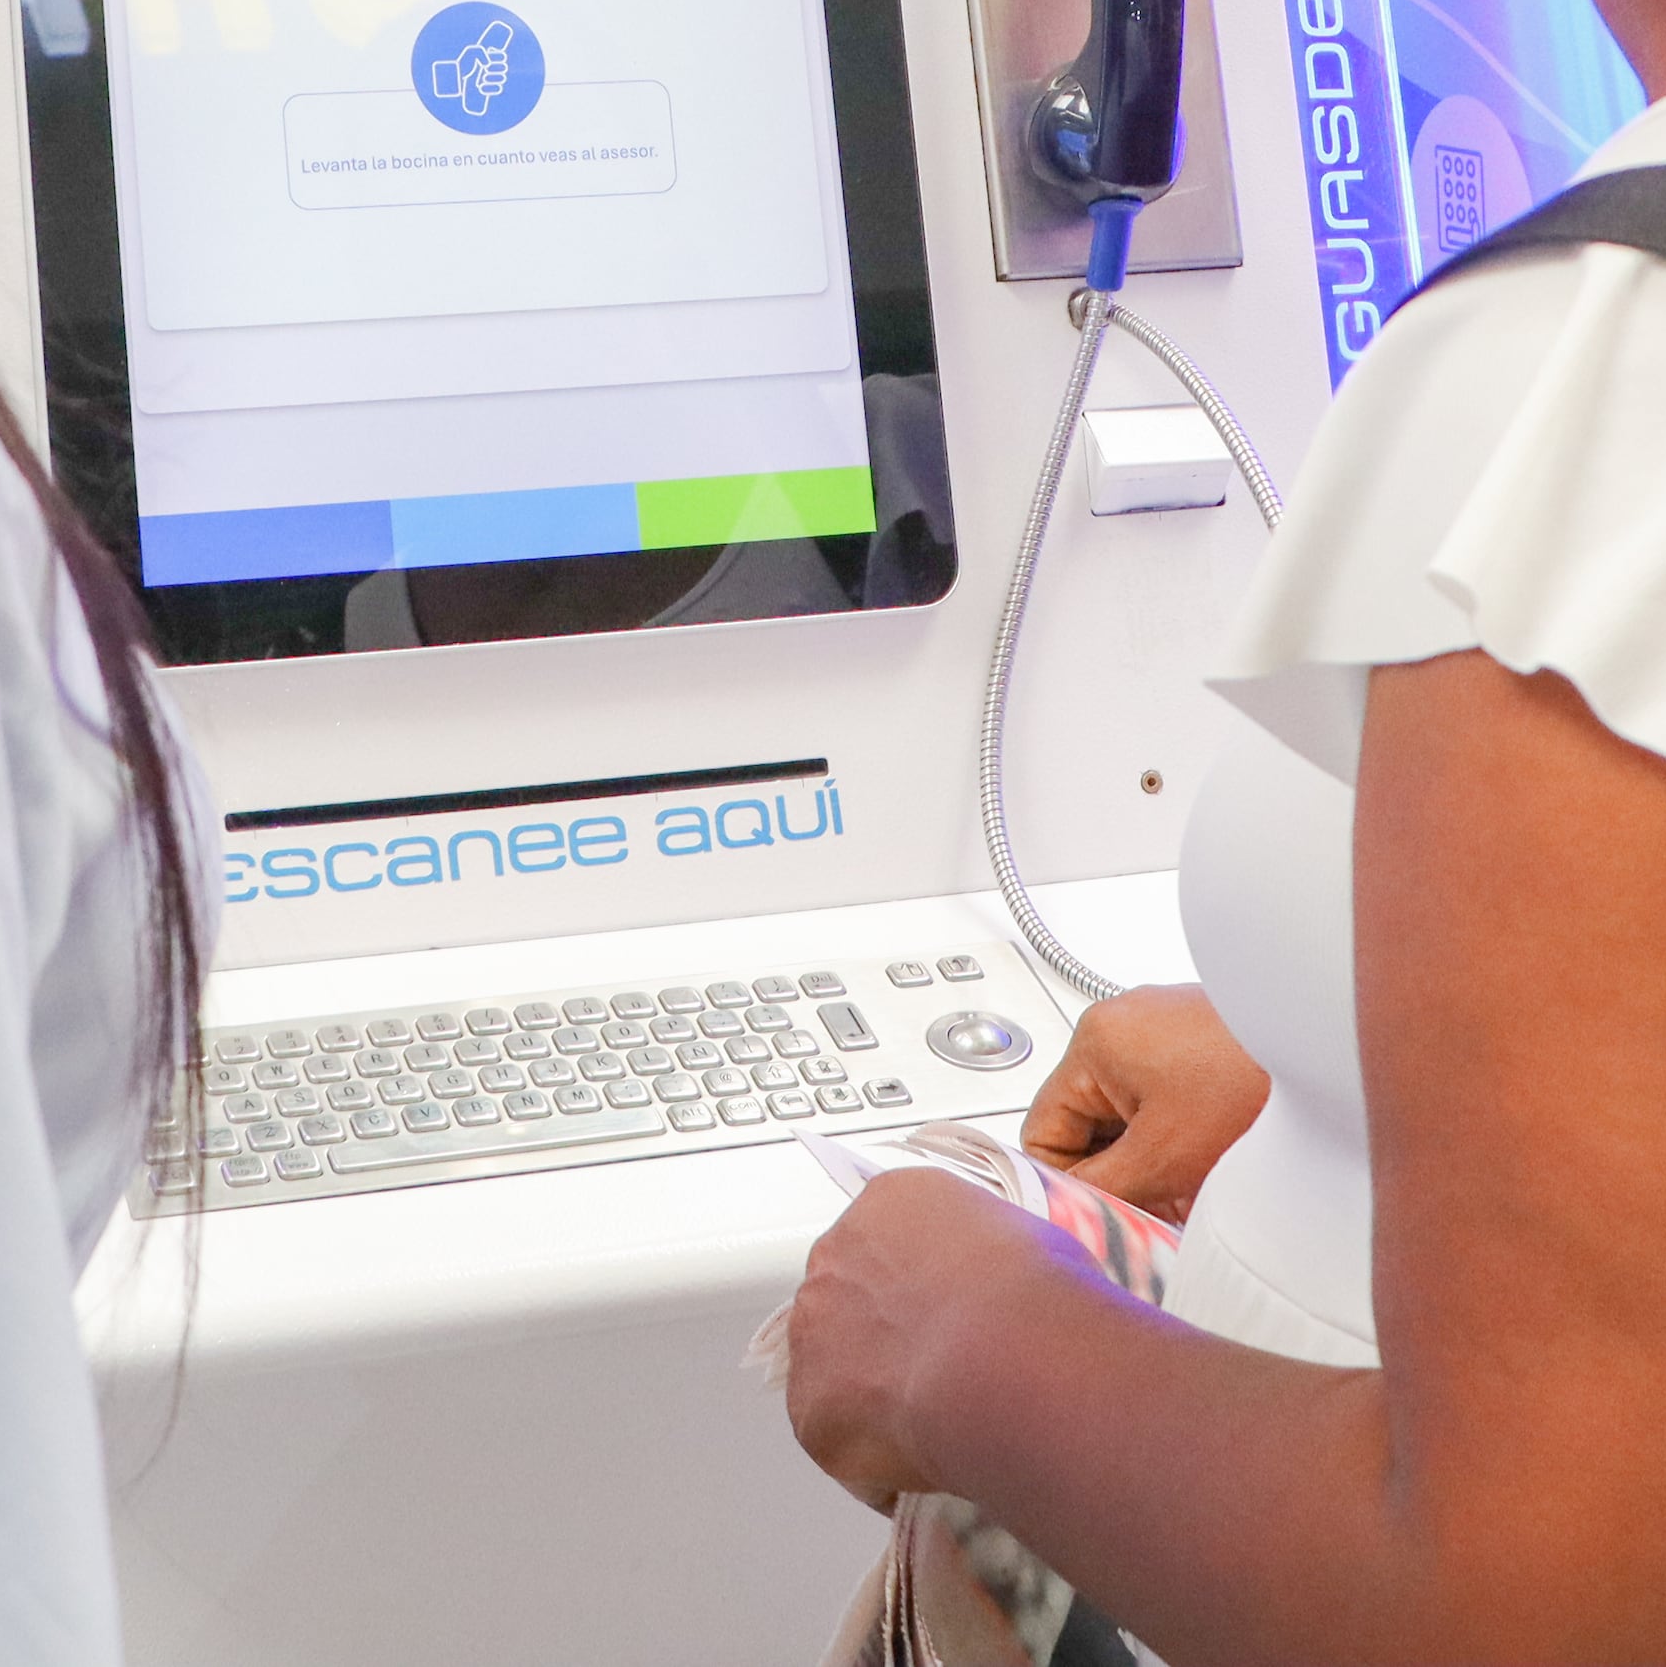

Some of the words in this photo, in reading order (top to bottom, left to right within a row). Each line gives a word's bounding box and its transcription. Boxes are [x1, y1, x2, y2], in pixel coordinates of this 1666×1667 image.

[300, 158, 368, 175] Levanta
[371, 156, 388, 171] la
[391, 152, 449, 170] bocina
[452, 154, 474, 167] en
[477, 149, 536, 166] cuanto
[538, 147, 578, 164] veas
[581, 146, 597, 160] al
[599, 145, 659, 160] asesor.
[224, 814, 629, 903] escanee
